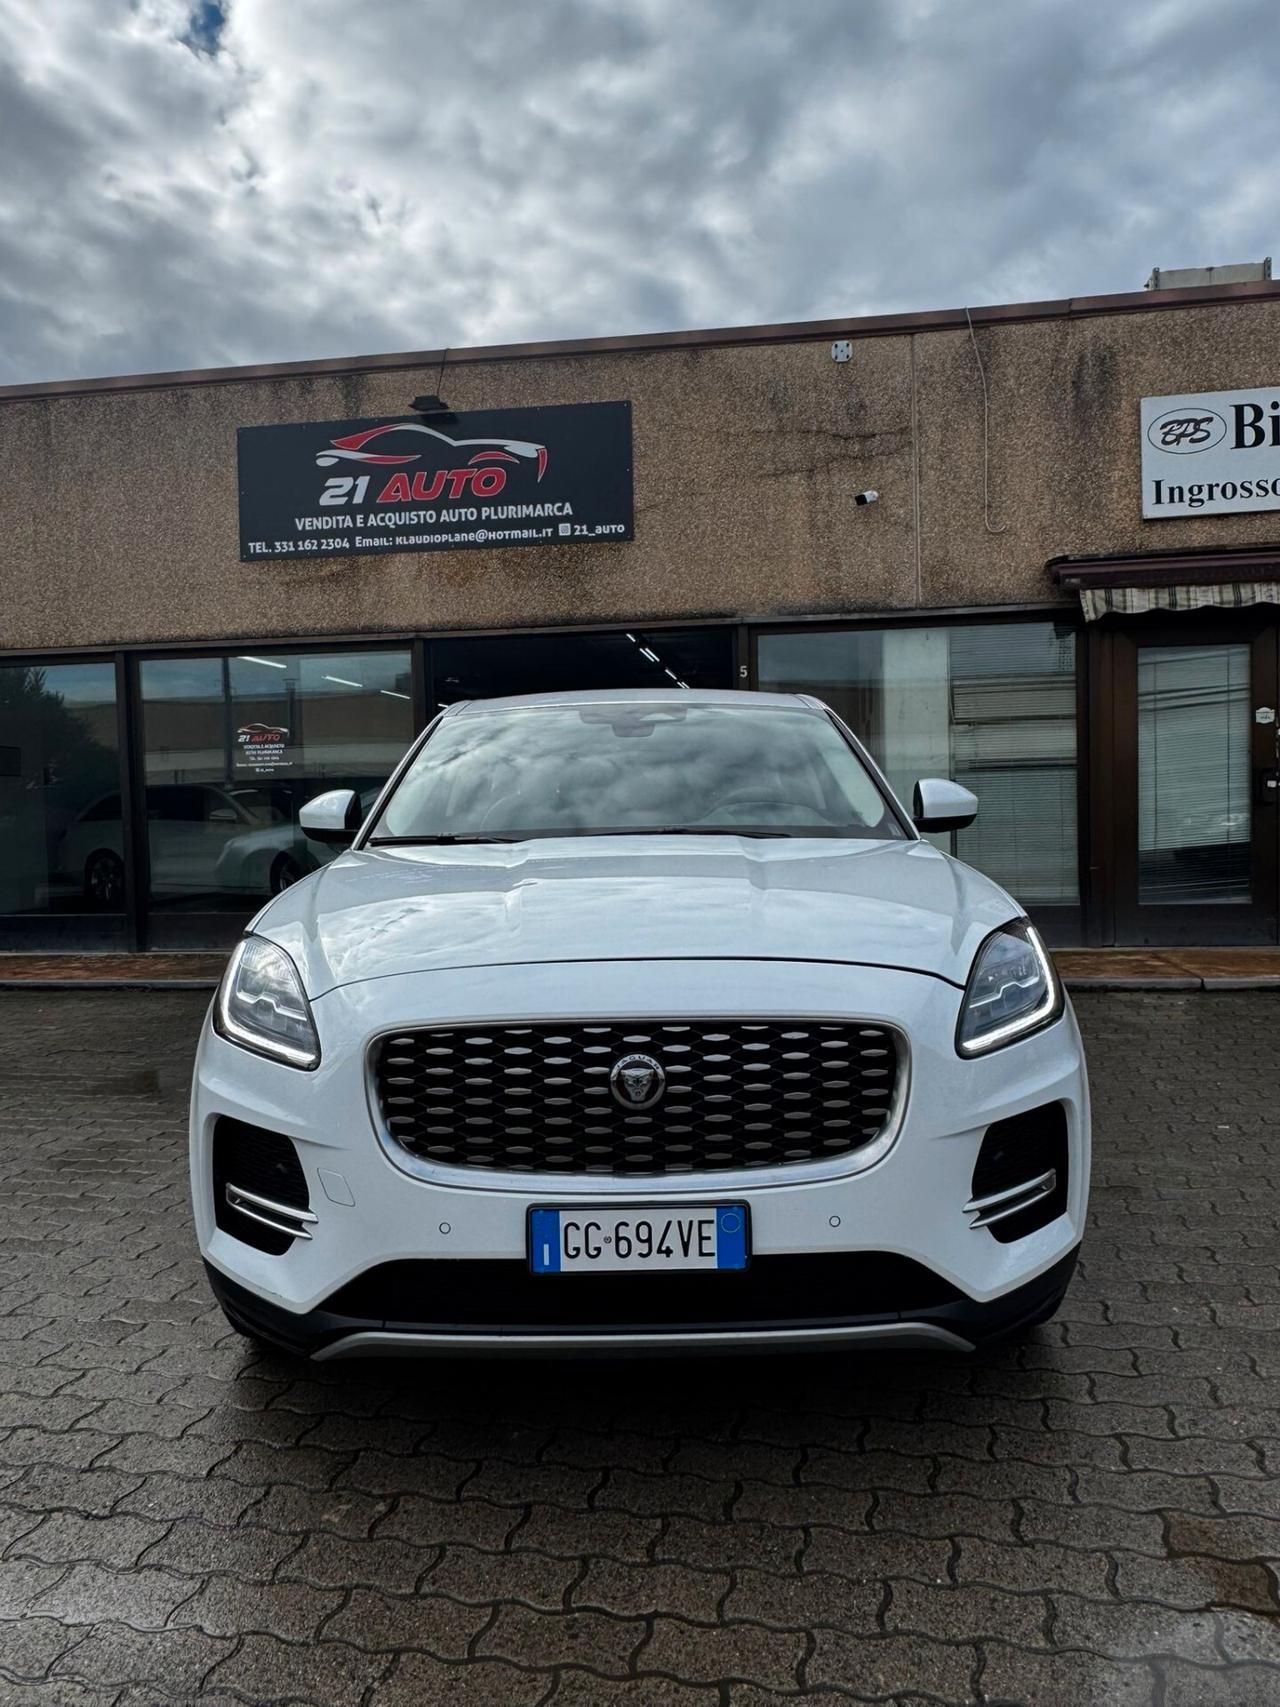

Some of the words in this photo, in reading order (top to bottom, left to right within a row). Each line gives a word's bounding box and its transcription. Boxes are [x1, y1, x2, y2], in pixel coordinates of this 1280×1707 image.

[319, 475, 371, 506] 21
[376, 467, 507, 504] AUTO
[295, 515, 353, 531] VENDITA
[356, 514, 364, 528] E
[367, 510, 436, 529] ACQUISTO
[440, 508, 478, 523] AUTO
[481, 502, 573, 520] PLURIMARCA
[248, 542, 272, 554] TEL.
[274, 541, 295, 552] 331
[297, 539, 318, 551] 162
[321, 538, 350, 549] 2304
[740, 665, 748, 678] 5
